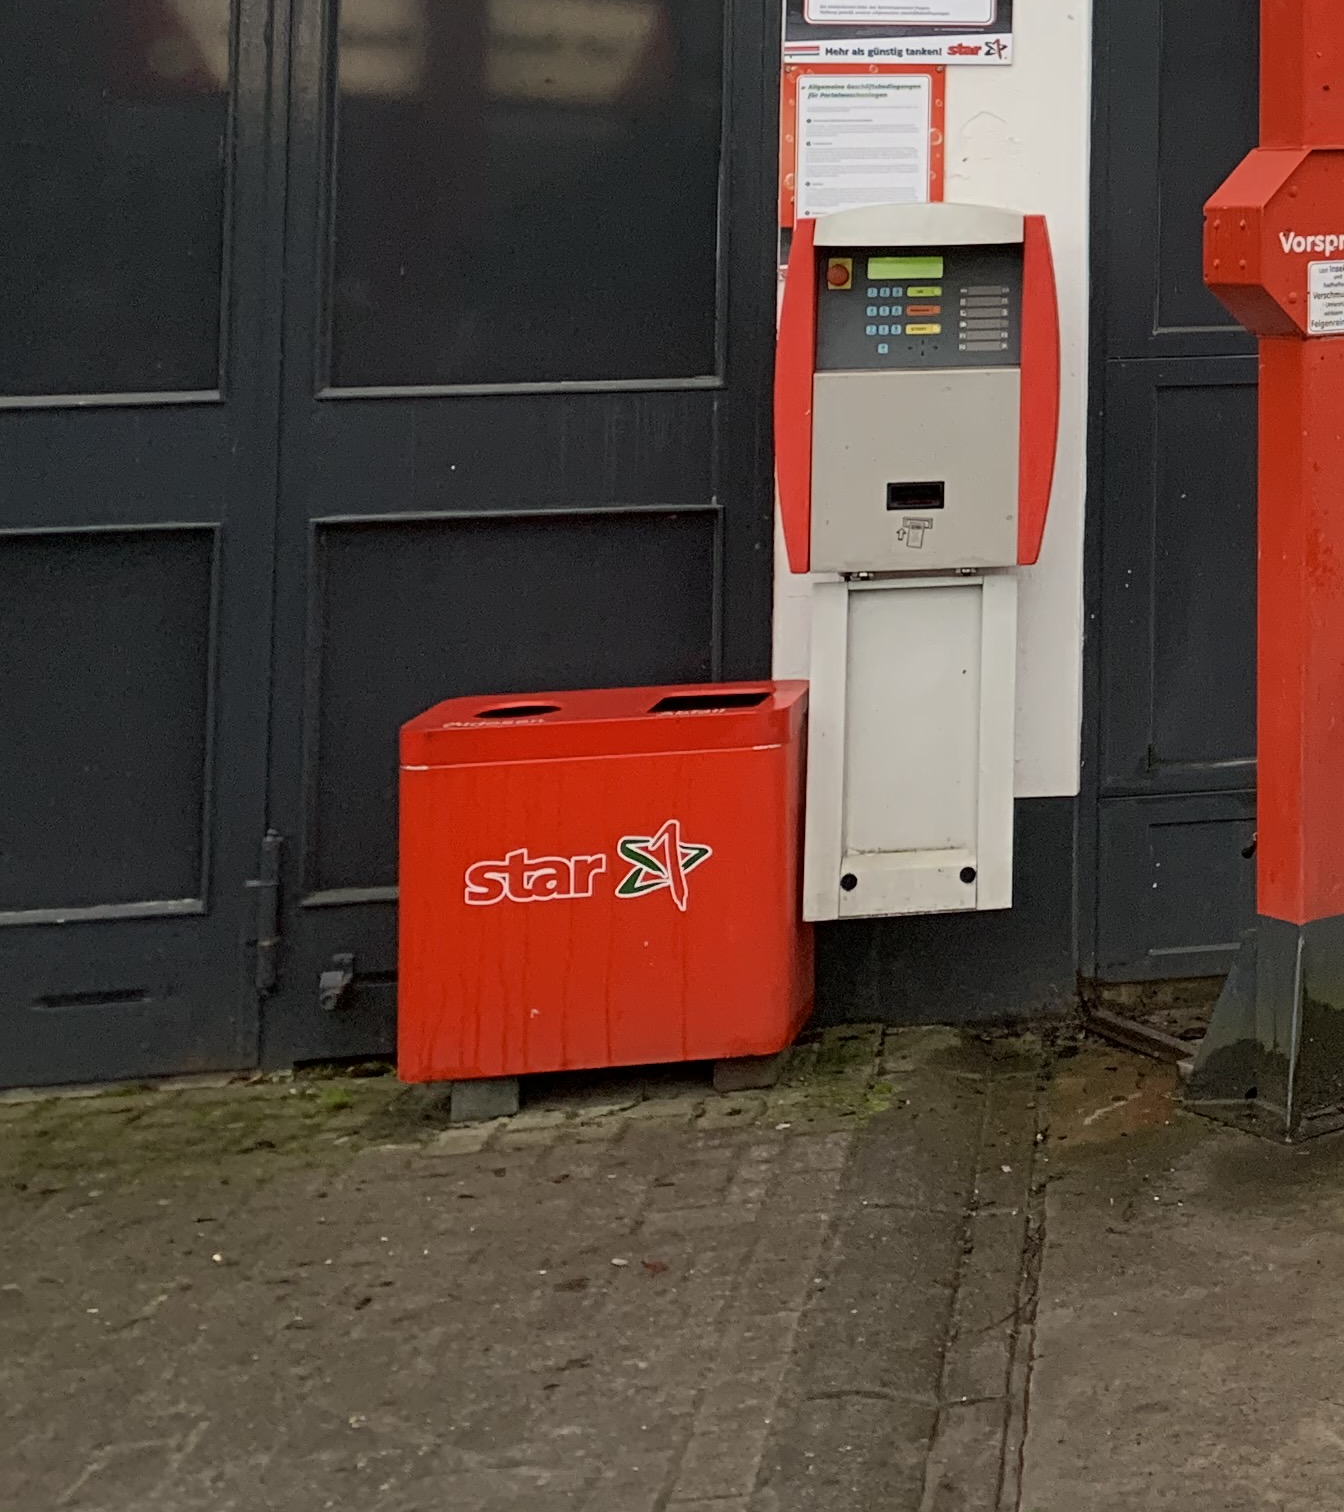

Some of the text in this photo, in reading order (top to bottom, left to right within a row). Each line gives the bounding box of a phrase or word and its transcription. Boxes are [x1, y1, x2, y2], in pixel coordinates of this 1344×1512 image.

[825, 42, 982, 59] Mehr als günstig tanken! star
[464, 848, 607, 906] star
